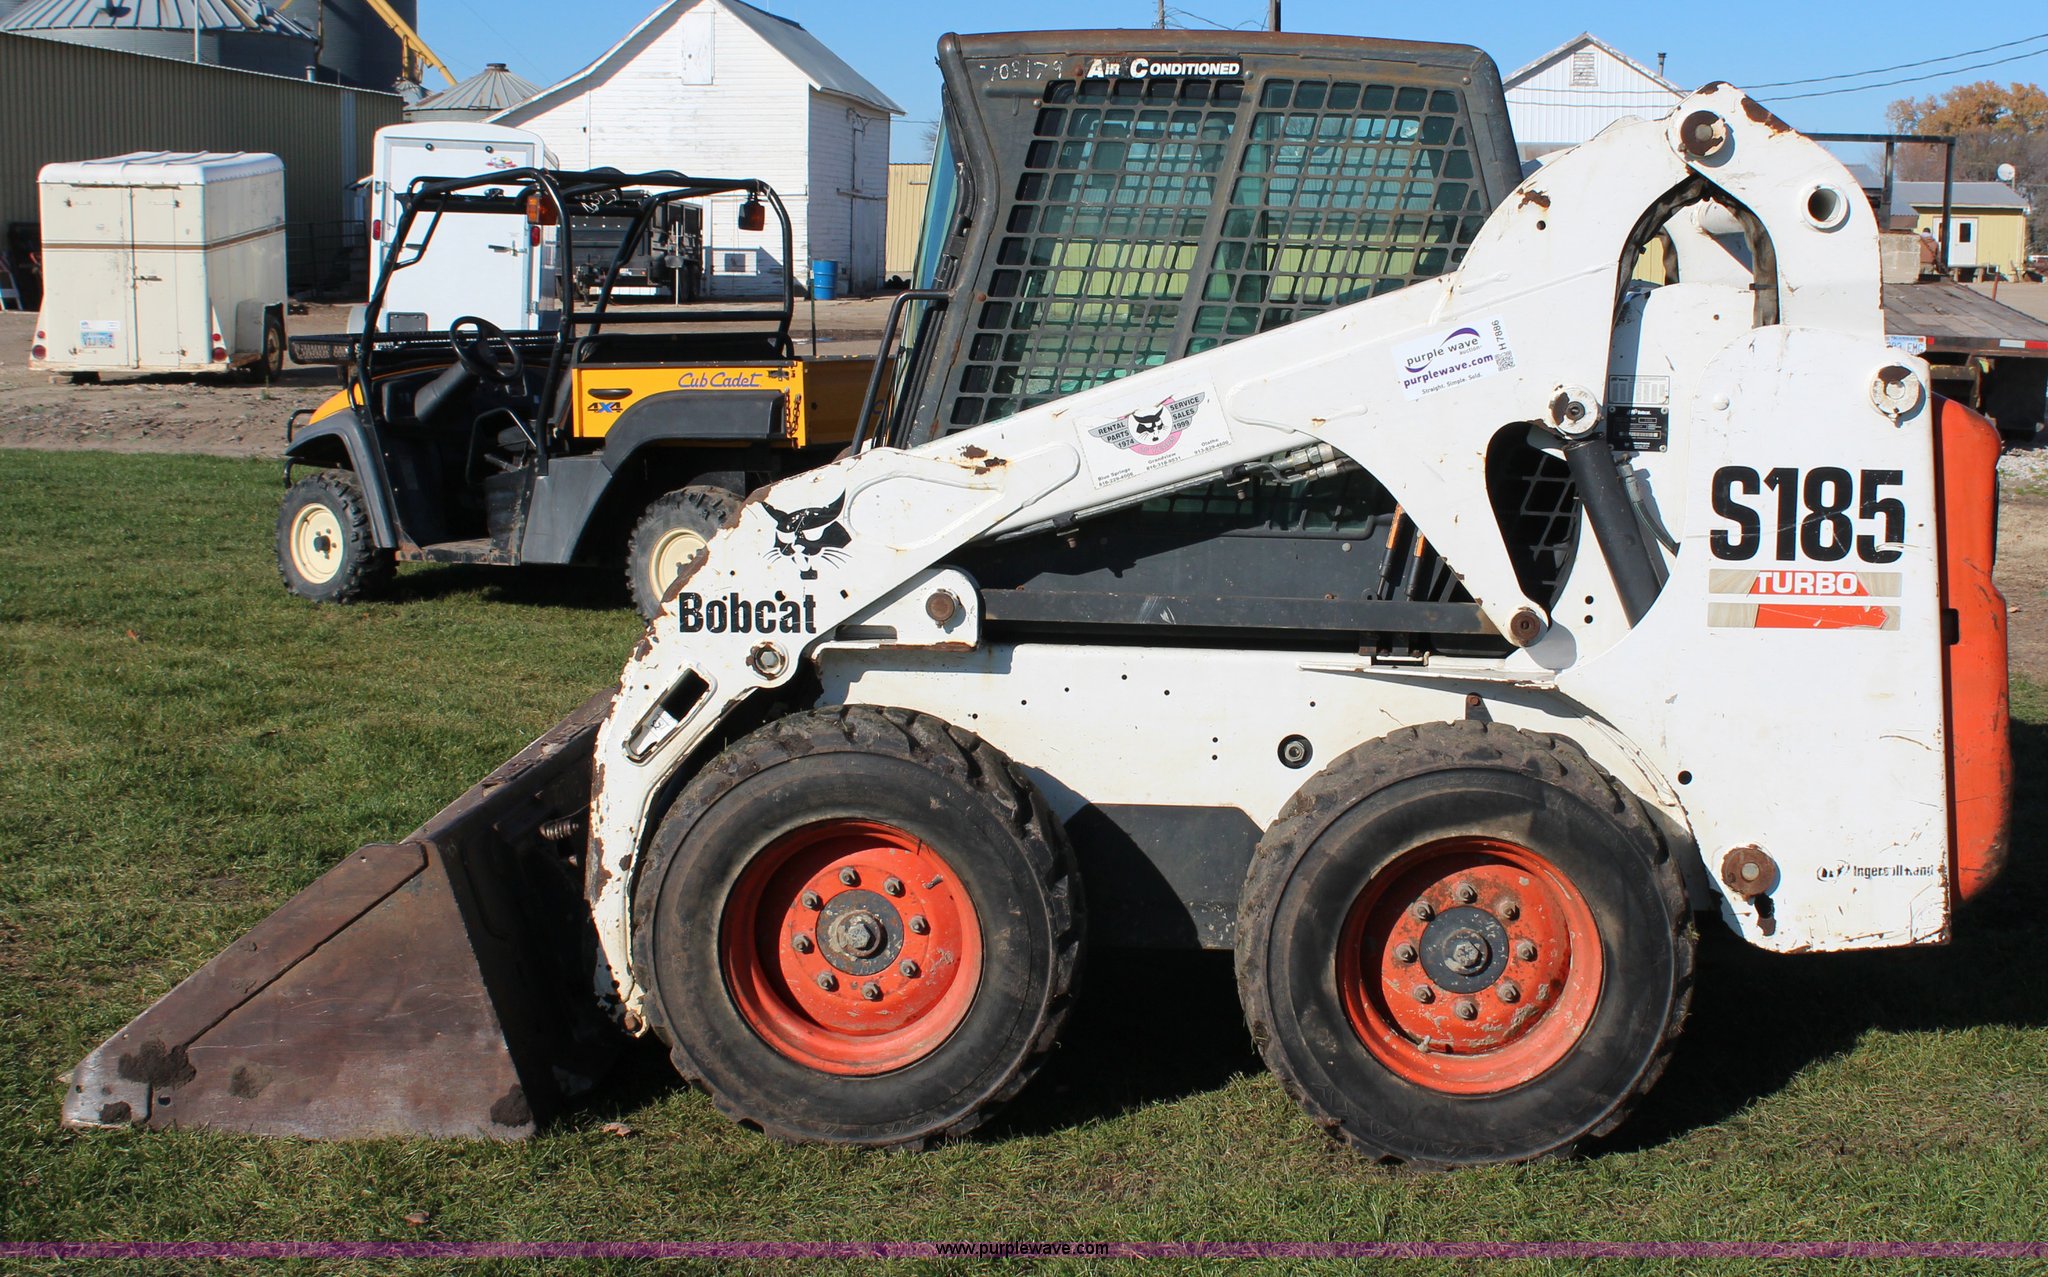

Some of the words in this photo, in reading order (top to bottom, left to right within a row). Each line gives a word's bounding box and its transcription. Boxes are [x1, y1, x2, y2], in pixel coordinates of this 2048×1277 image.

[1492, 319, 1504, 343] 7886
[1406, 348, 1444, 367] purple
[1447, 338, 1479, 353] wave
[1403, 354, 1494, 389] purplewave.com
[677, 372, 708, 388] Cub
[709, 372, 762, 388] Cadet
[1421, 384, 1446, 394] Straight.
[1446, 377, 1468, 388] Simple.
[1169, 396, 1200, 411] SERVICE
[1172, 408, 1195, 421] SALES
[1098, 422, 1126, 435] RENTAL
[1173, 419, 1190, 430] 1999
[1106, 430, 1130, 442] PARTS
[1118, 438, 1135, 449] 1974
[1709, 465, 1905, 564] S185
[1757, 571, 1858, 595] TURBO
[678, 592, 817, 634] Bobcat
